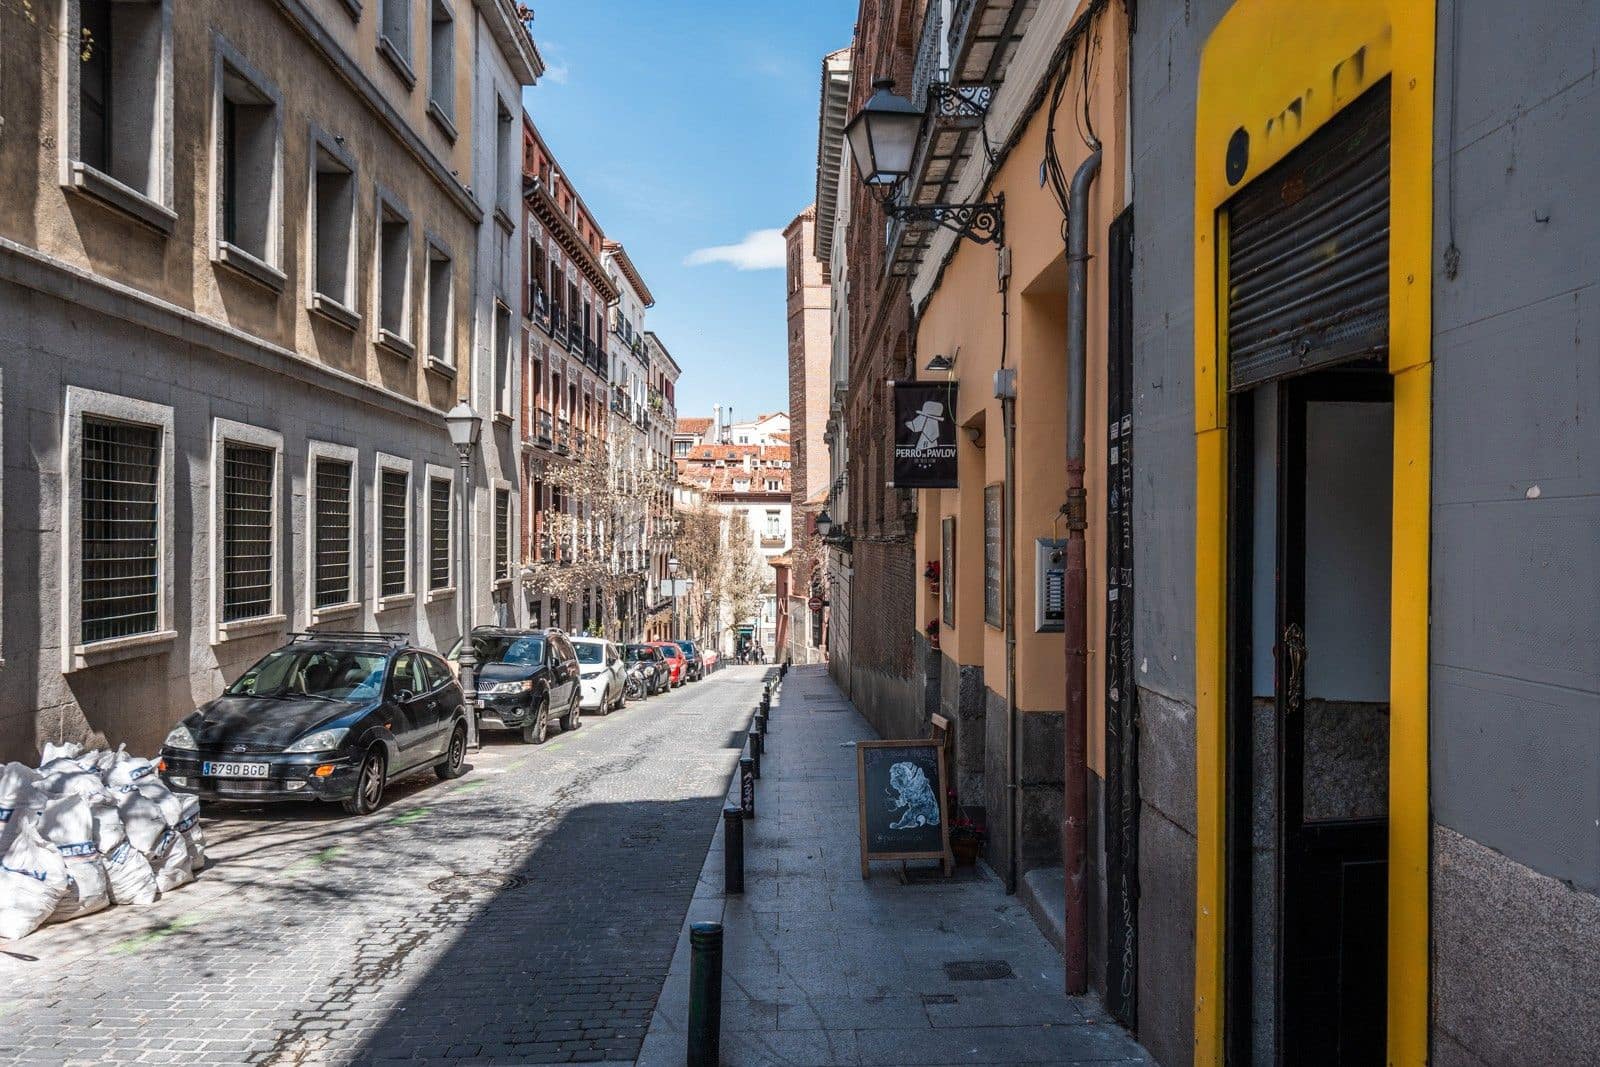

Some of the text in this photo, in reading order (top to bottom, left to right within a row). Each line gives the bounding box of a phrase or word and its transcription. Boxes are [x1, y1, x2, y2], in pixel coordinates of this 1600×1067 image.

[895, 448, 922, 458] PERRO
[926, 448, 956, 458] PAVLOV
[210, 763, 265, 776] 6790 BGC
